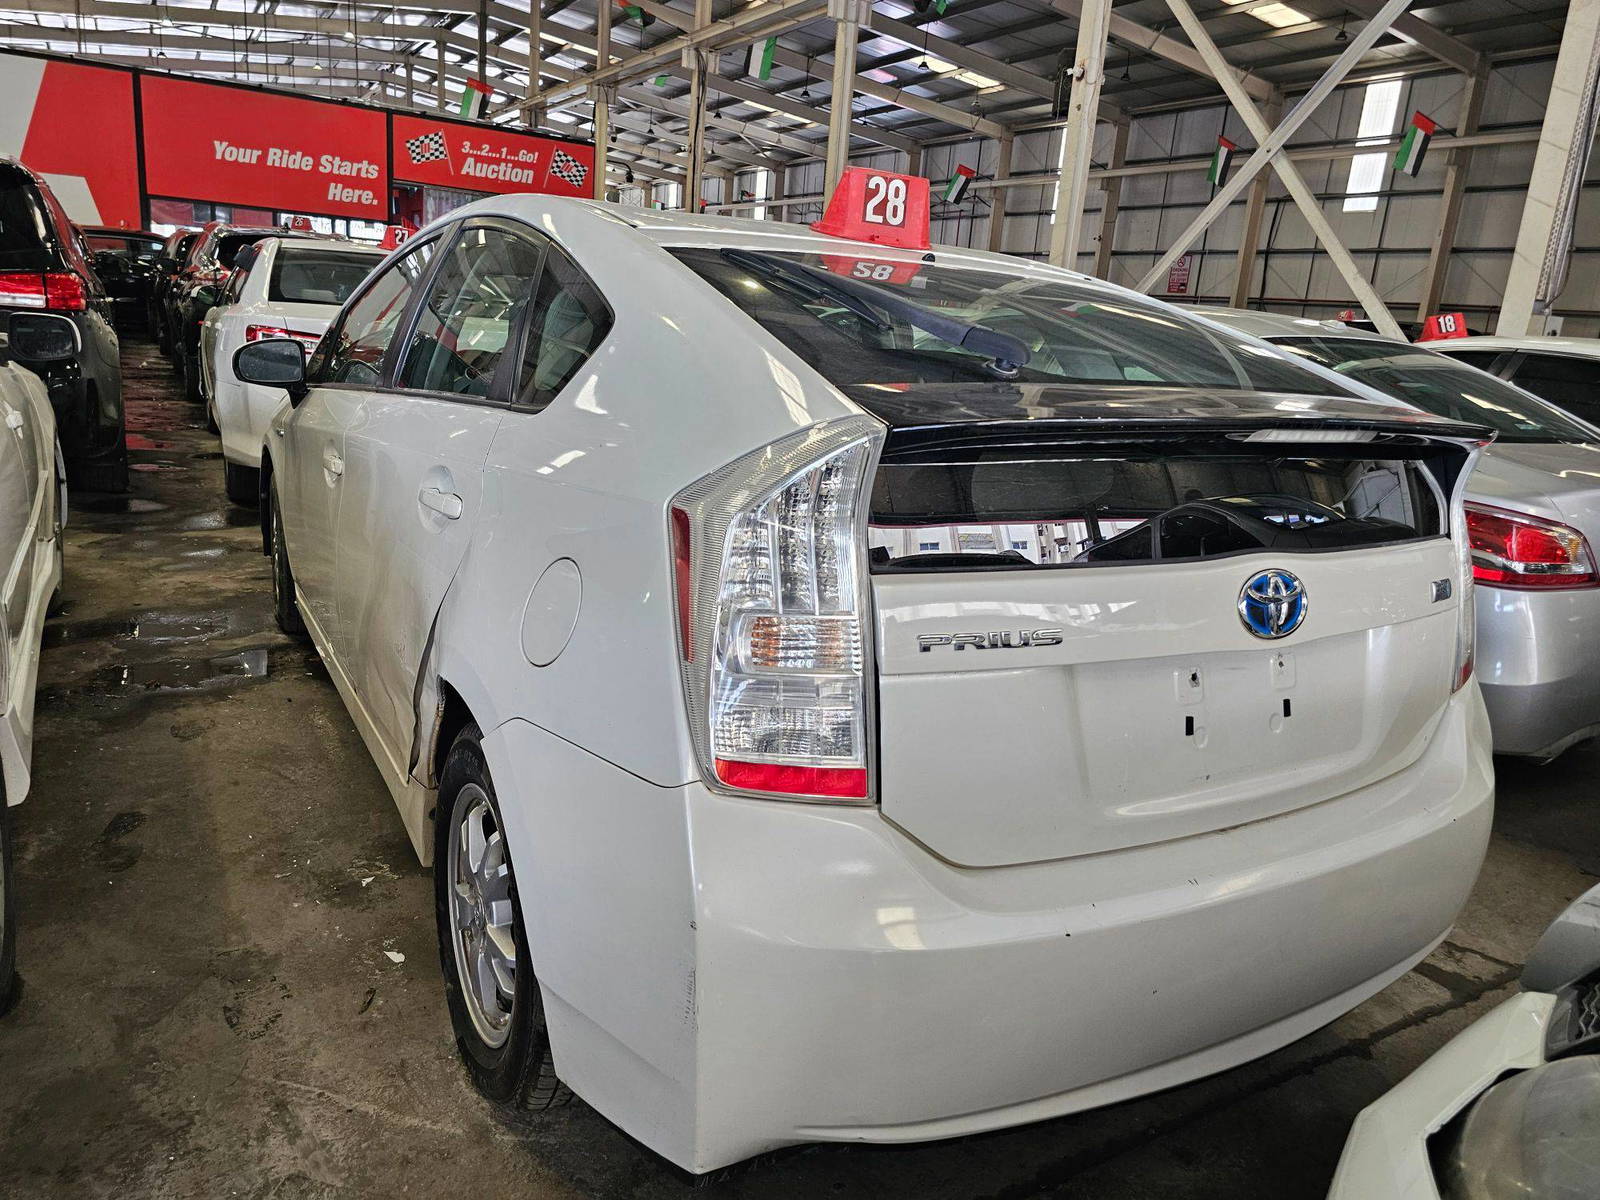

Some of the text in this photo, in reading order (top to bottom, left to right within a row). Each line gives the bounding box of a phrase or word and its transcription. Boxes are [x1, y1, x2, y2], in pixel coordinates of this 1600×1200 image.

[213, 140, 379, 179] Your Ride Starts
[461, 157, 534, 184] Auction
[328, 183, 379, 205] Here.
[865, 175, 907, 226] 28
[395, 229, 409, 245] 27
[1438, 315, 1456, 333] 18
[917, 628, 1064, 652] PRIUS
